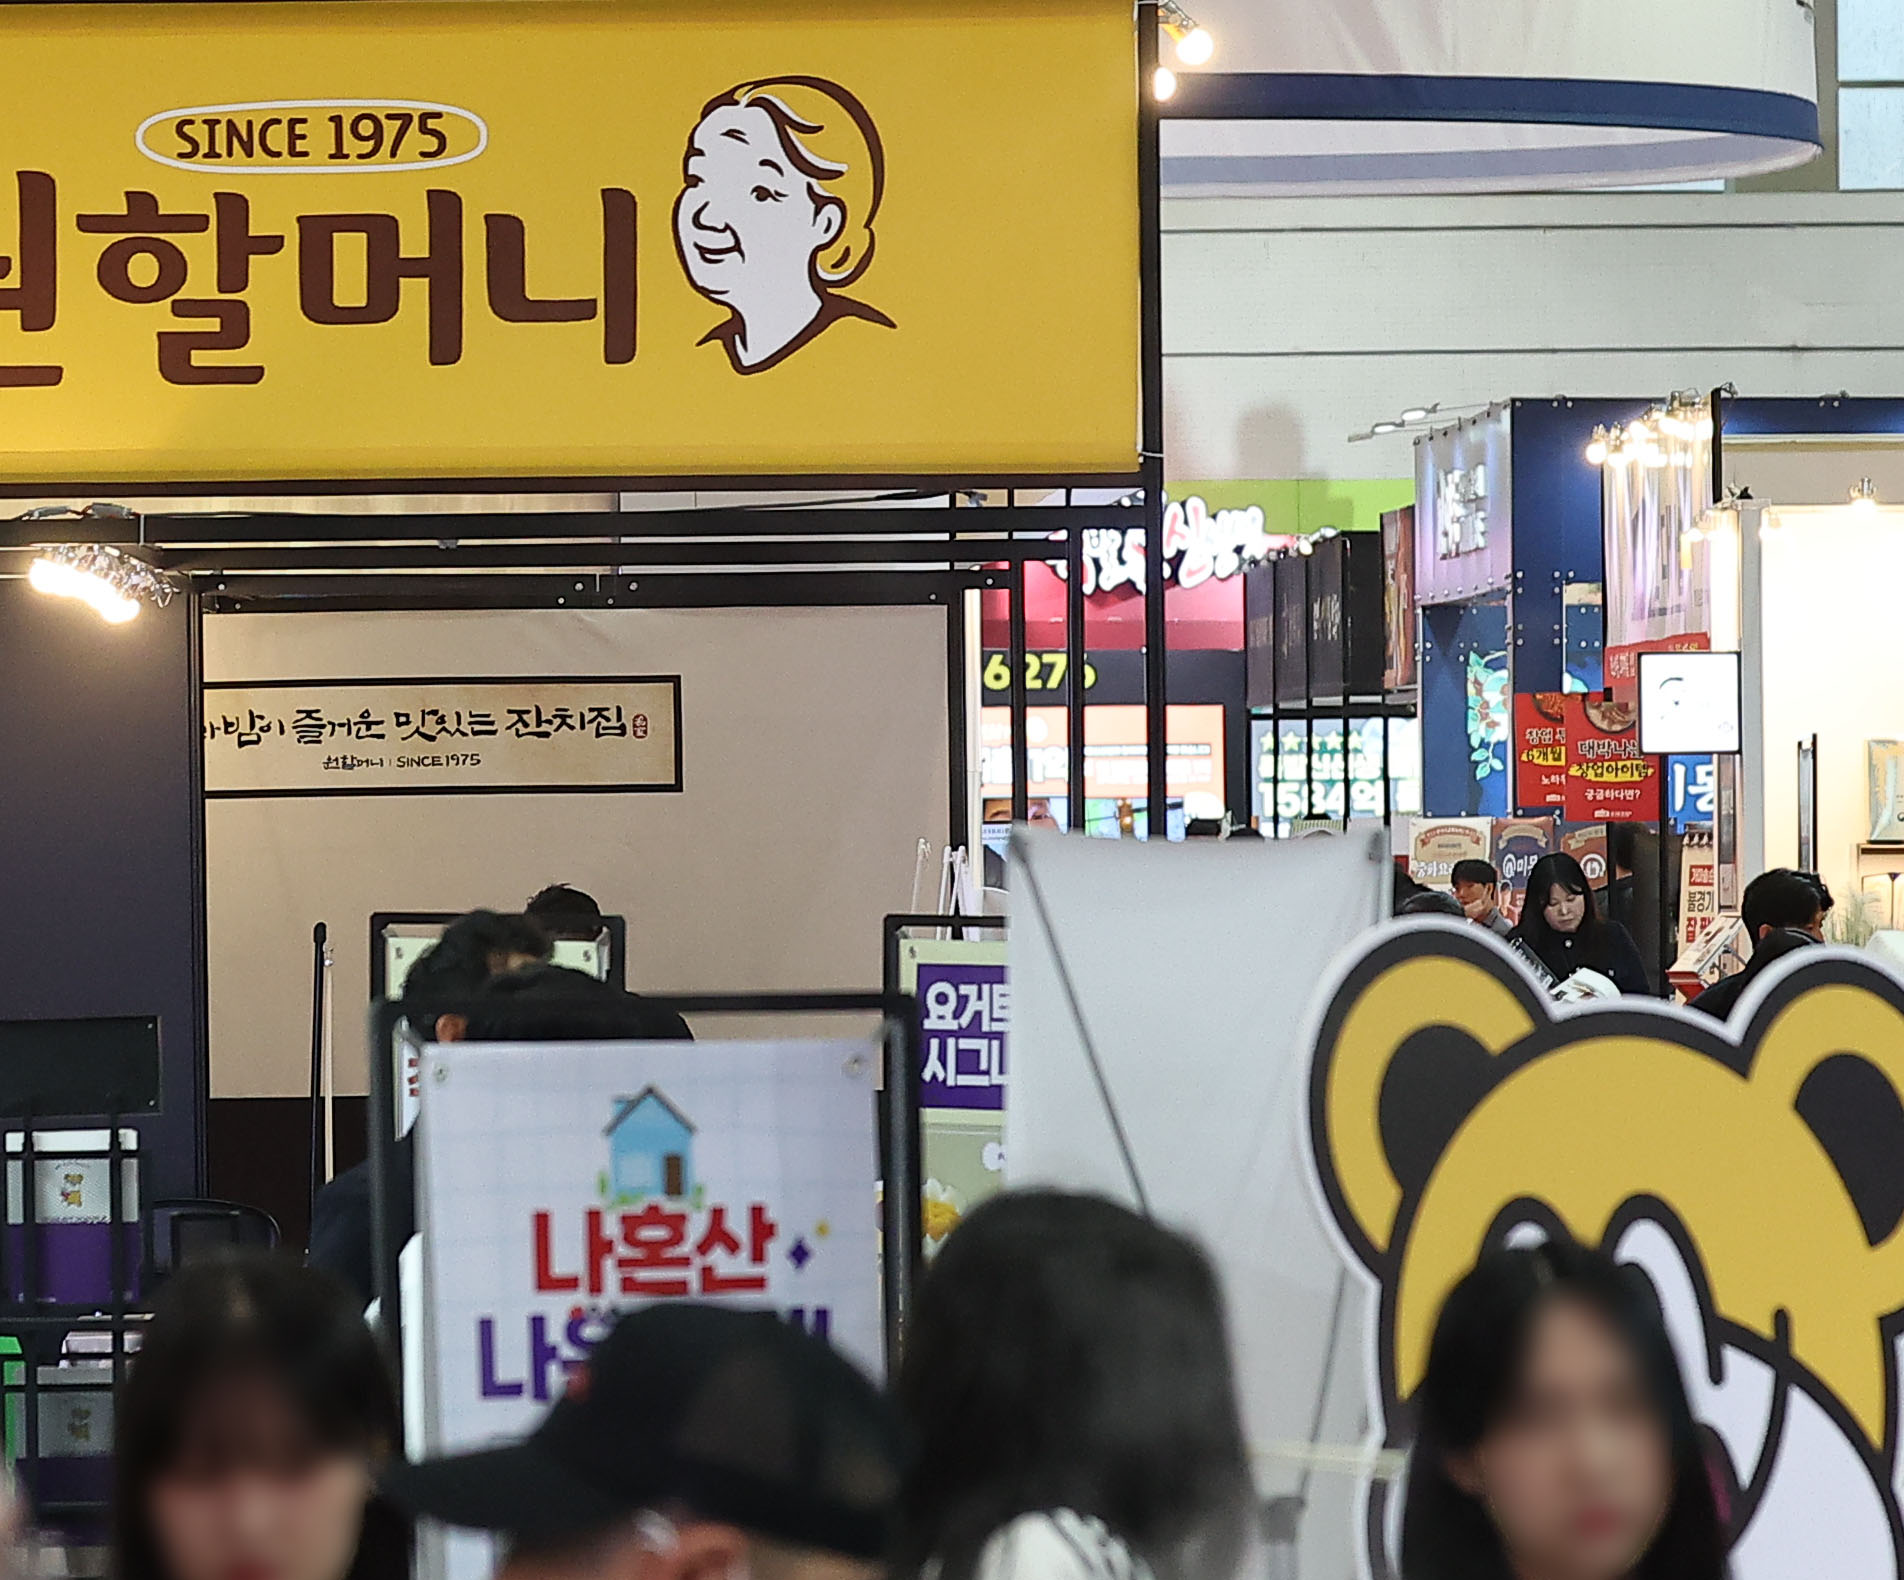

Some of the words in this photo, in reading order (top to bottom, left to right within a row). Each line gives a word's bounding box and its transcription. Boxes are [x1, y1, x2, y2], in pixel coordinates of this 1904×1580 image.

[173, 115, 309, 160] SINCE
[325, 110, 449, 160] 1975
[292, 708, 386, 744] 즐거운
[393, 708, 498, 742] 맛있는
[505, 704, 627, 739] 잔치집
[531, 1203, 782, 1297] 나혼산
